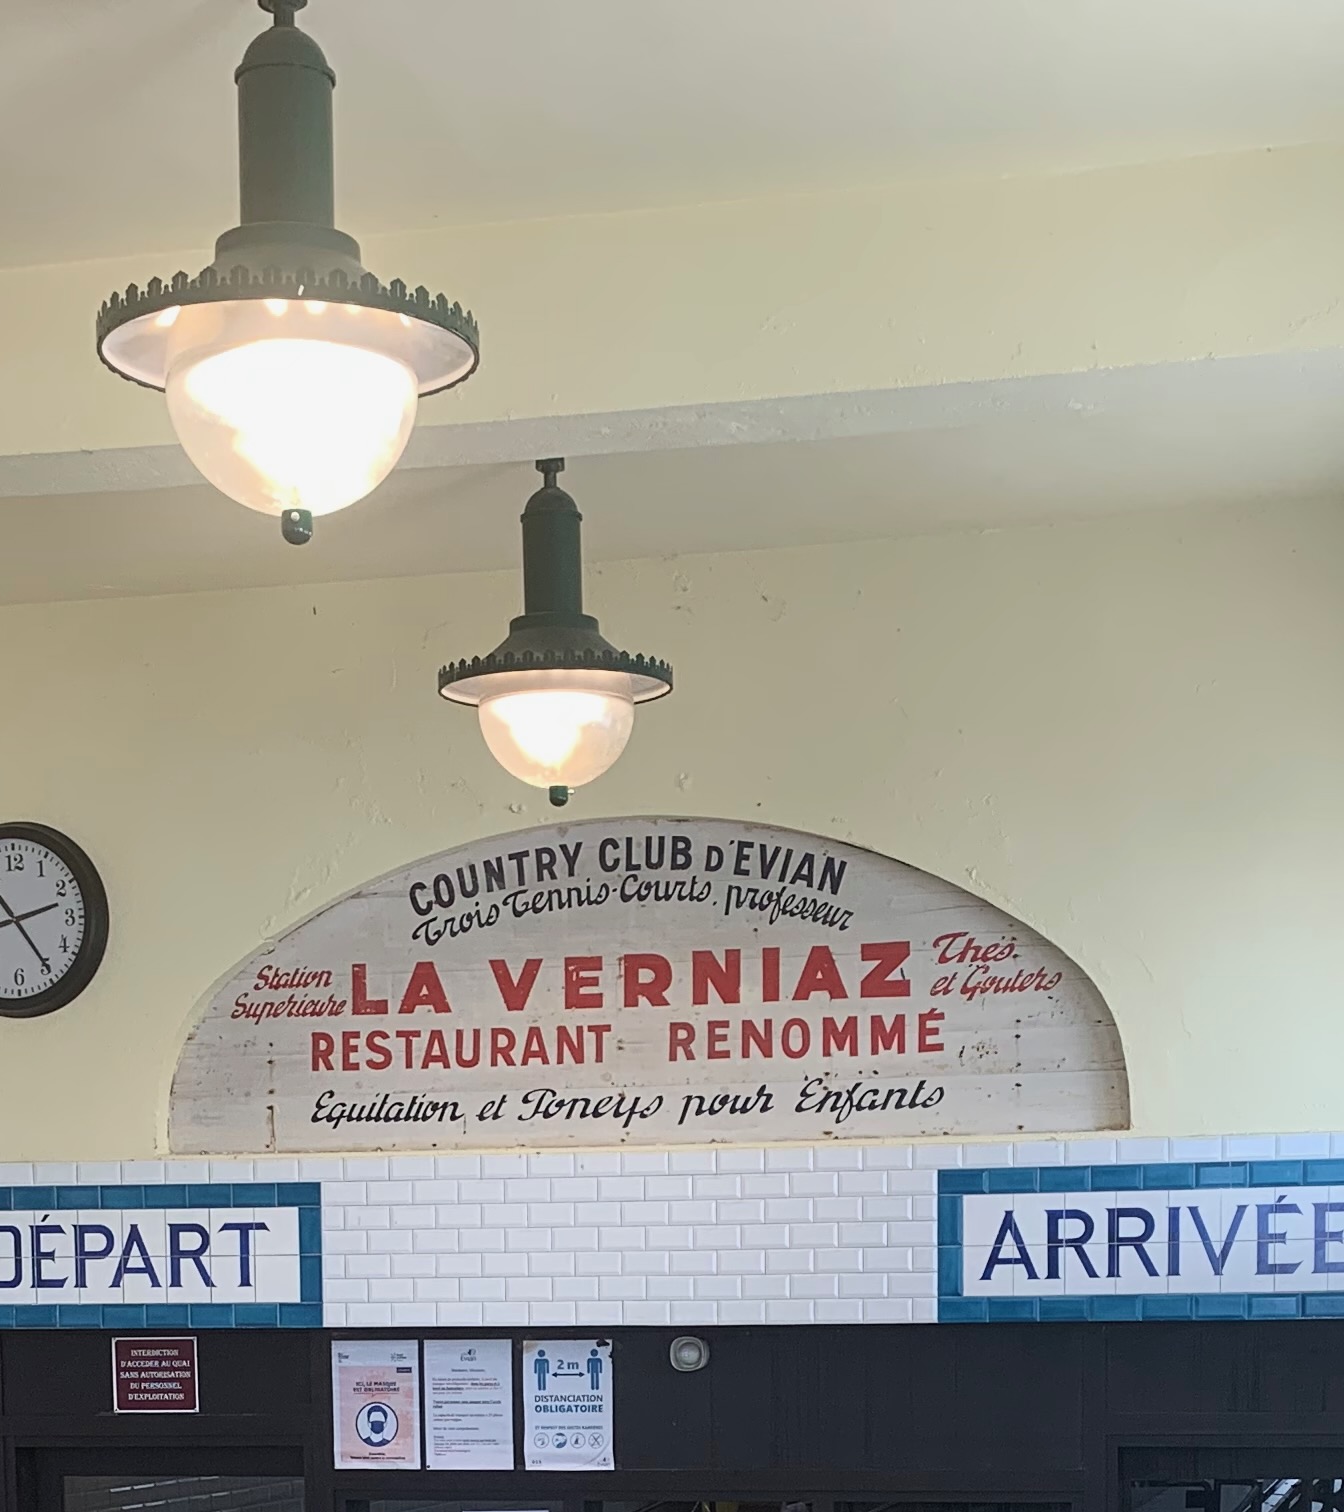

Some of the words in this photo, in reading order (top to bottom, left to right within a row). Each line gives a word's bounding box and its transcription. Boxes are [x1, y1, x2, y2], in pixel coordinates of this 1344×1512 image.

[6, 853, 25, 871] 12
[37, 860, 45, 877] 1
[409, 841, 583, 917] COUNTRY
[598, 835, 692, 873] CLUB
[56, 879, 67, 897] 2
[64, 908, 76, 926] 3
[412, 901, 501, 946] Trois
[724, 883, 855, 931] professeur
[58, 934, 70, 953] 4
[40, 957, 52, 976] 5
[14, 968, 25, 986] 6
[253, 964, 333, 991] Station
[351, 961, 452, 1016] LA
[488, 941, 912, 1012] VERNIAZ
[930, 971, 958, 996] et
[310, 1024, 612, 1072] RESTAURANT
[668, 1007, 946, 1061] RENOMMÉ
[310, 1089, 465, 1130] Equitation
[475, 1094, 508, 1122] et
[517, 1088, 663, 1128] Poneys
[678, 1083, 775, 1125] pour
[794, 1076, 946, 1124] Enfants
[557, 1359, 564, 1370] 2
[567, 1361, 579, 1370] m
[534, 1404, 603, 1413] OBLIGATOIRE
